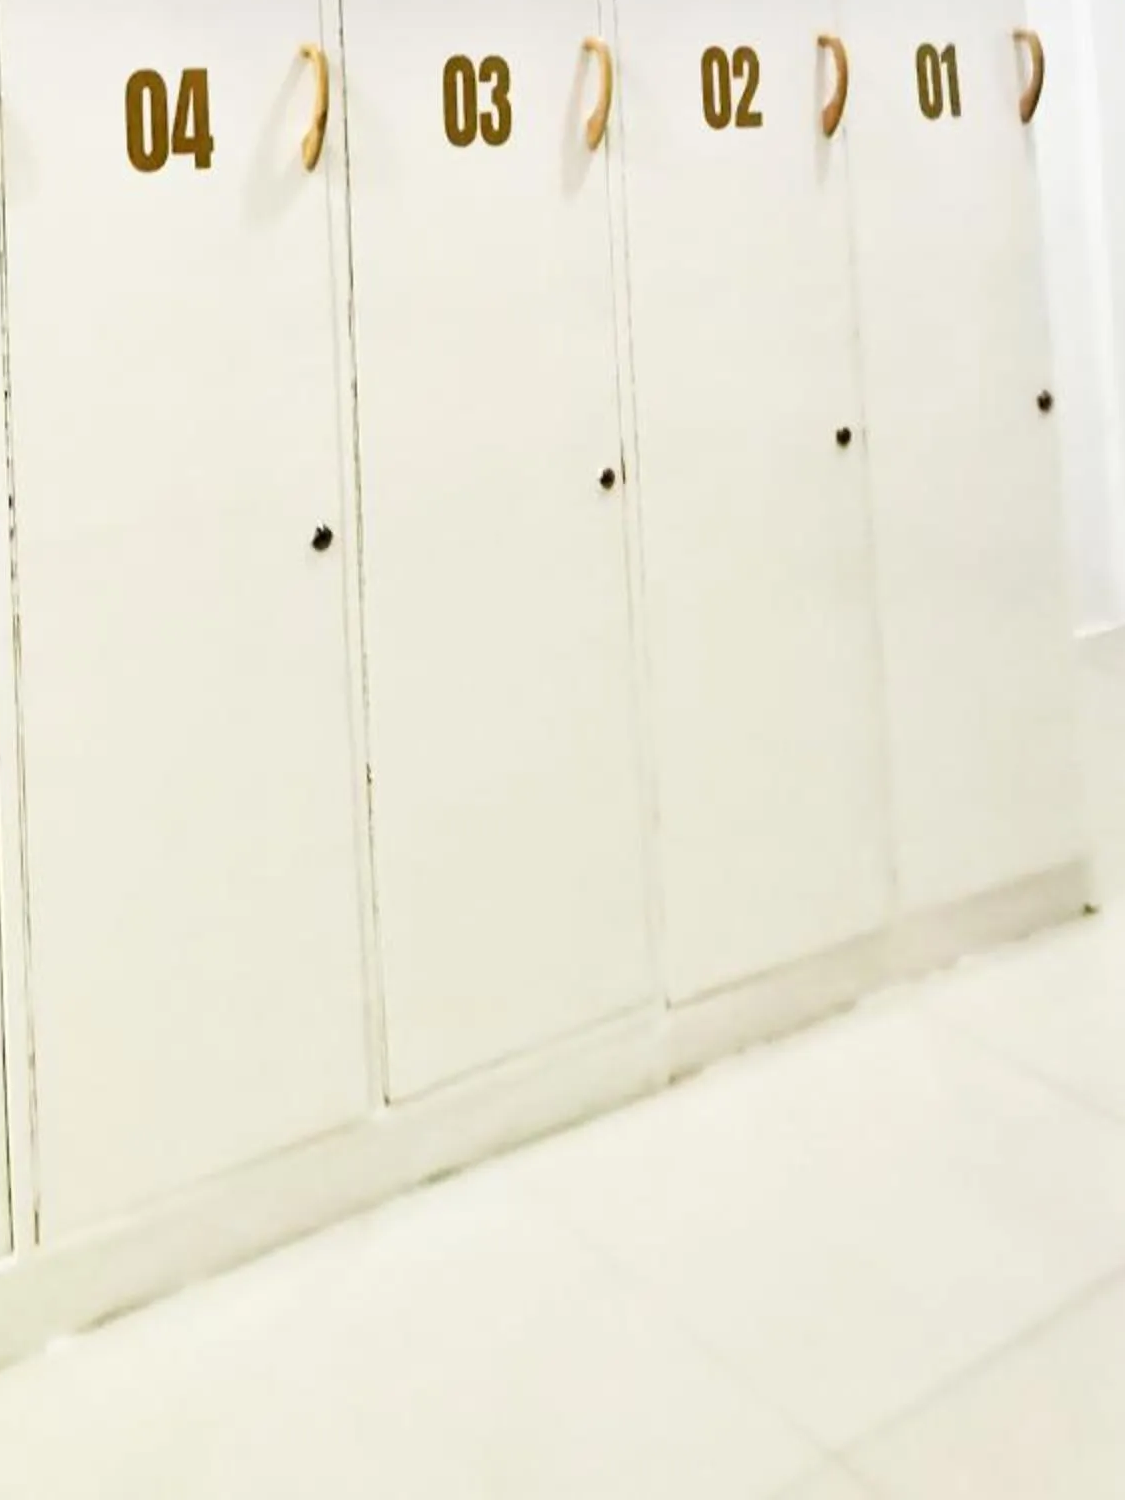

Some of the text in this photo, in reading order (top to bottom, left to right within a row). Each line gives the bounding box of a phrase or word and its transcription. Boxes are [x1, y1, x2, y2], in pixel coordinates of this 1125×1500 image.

[125, 68, 215, 174] 04
[442, 55, 513, 148] 03
[701, 46, 763, 130] 02
[916, 43, 962, 120] 01
